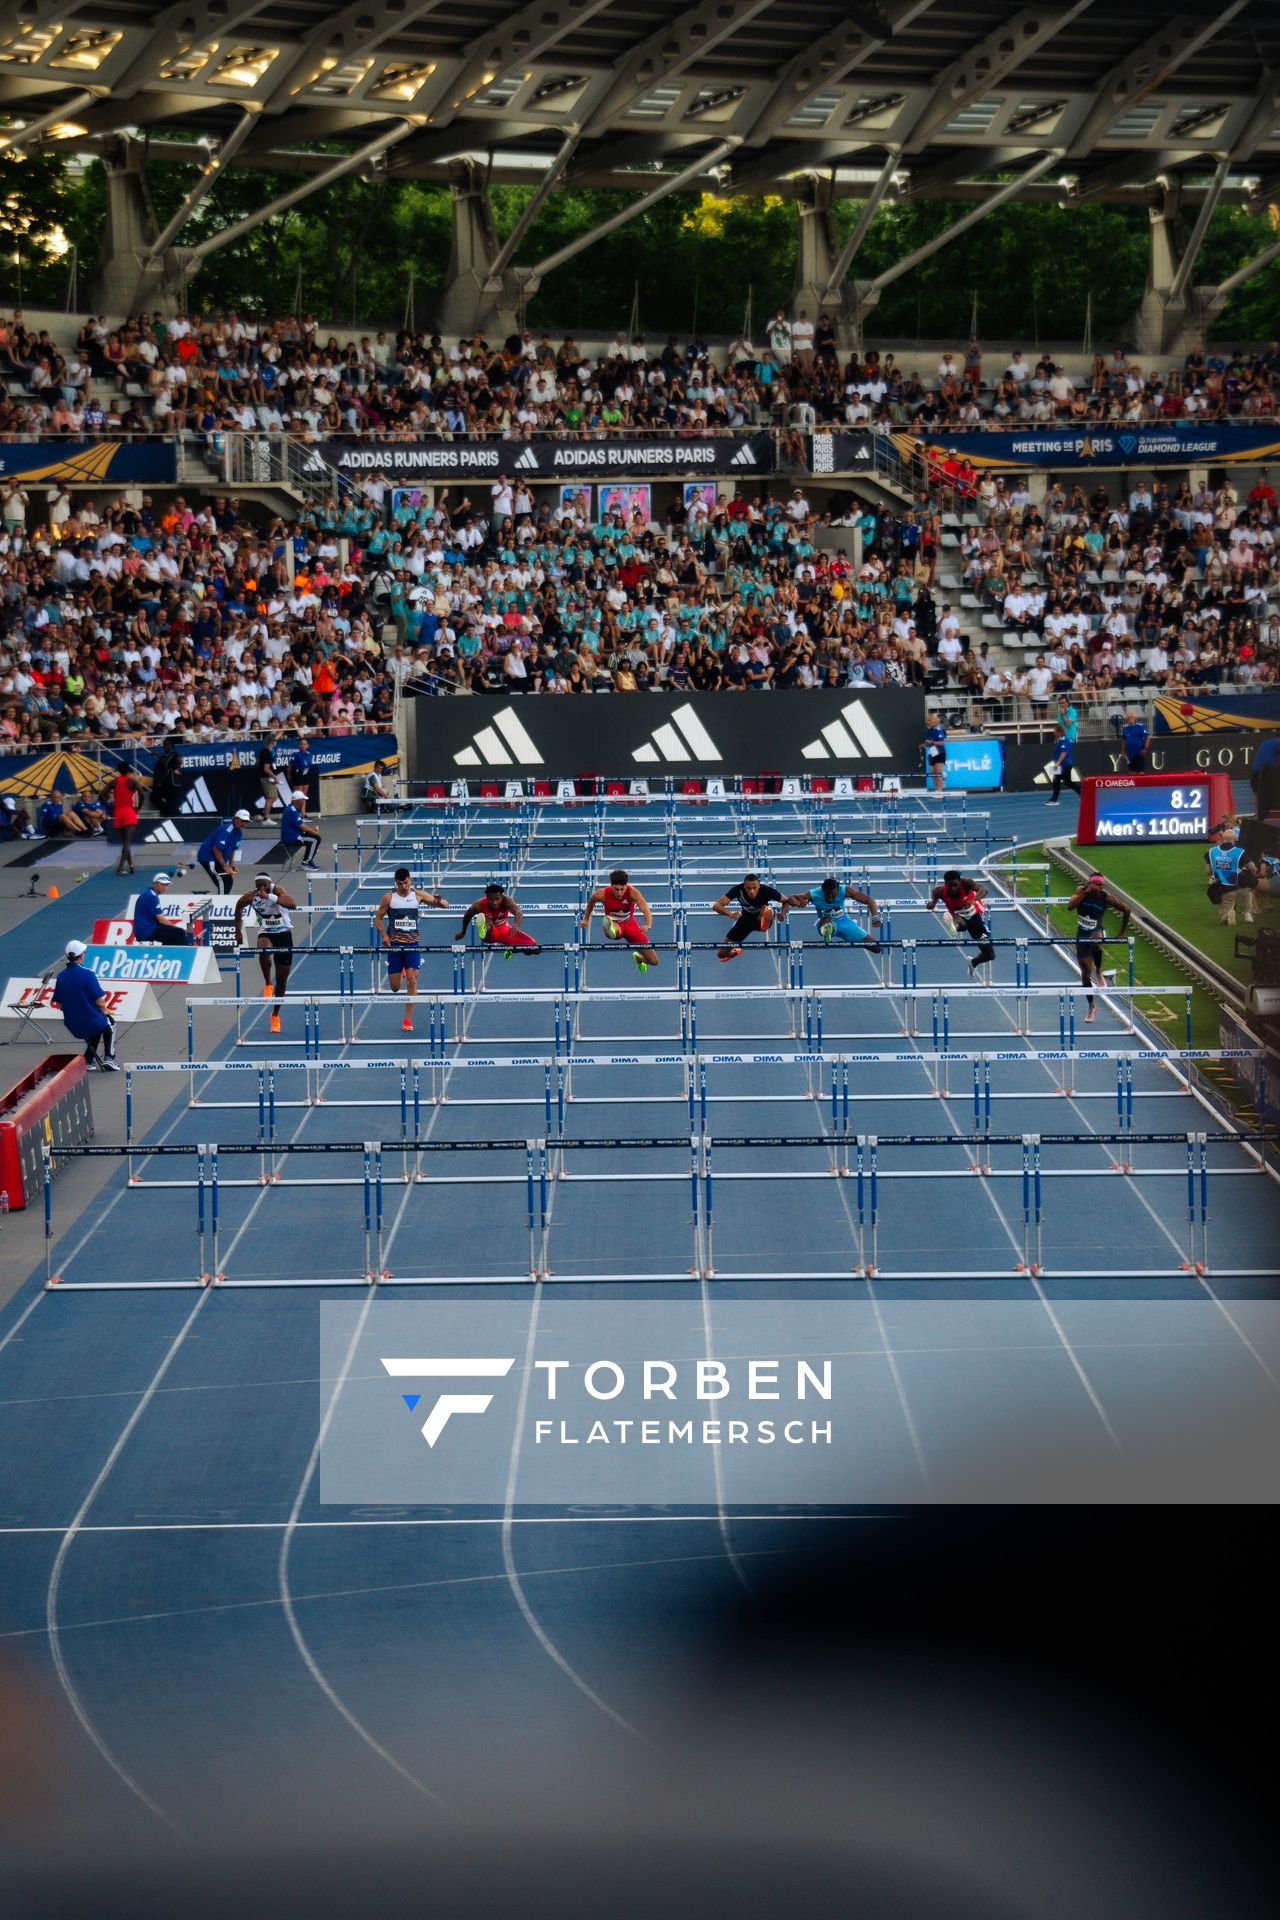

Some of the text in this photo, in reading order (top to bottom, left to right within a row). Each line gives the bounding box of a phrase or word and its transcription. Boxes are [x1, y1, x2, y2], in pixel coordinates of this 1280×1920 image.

[813, 434, 832, 444] PARIS
[813, 444, 832, 453] PARIS
[1012, 441, 1061, 453] MEETING
[1076, 438, 1113, 456] PARIS
[1138, 443, 1217, 454] DIAMOND LEAGUE
[339, 451, 499, 467] ADIDAS RUNNERS PARIS
[554, 448, 715, 465] ADIDAS RUNNERS PARIS
[813, 454, 832, 463] PARIS
[813, 463, 833, 472] PARIS
[181, 750, 256, 768] EETING DE PARIS
[312, 753, 341, 764] LEAGUE
[945, 755, 991, 771] THLÉ
[1109, 747, 1253, 772] YU GOT
[563, 788, 570, 797] 6
[712, 786, 719, 796] 4
[788, 784, 795, 794] 3
[840, 784, 847, 794] 2
[1171, 791, 1201, 809] 8.2
[1096, 818, 1206, 837] Men's 110mH
[108, 951, 182, 979] Parisien
